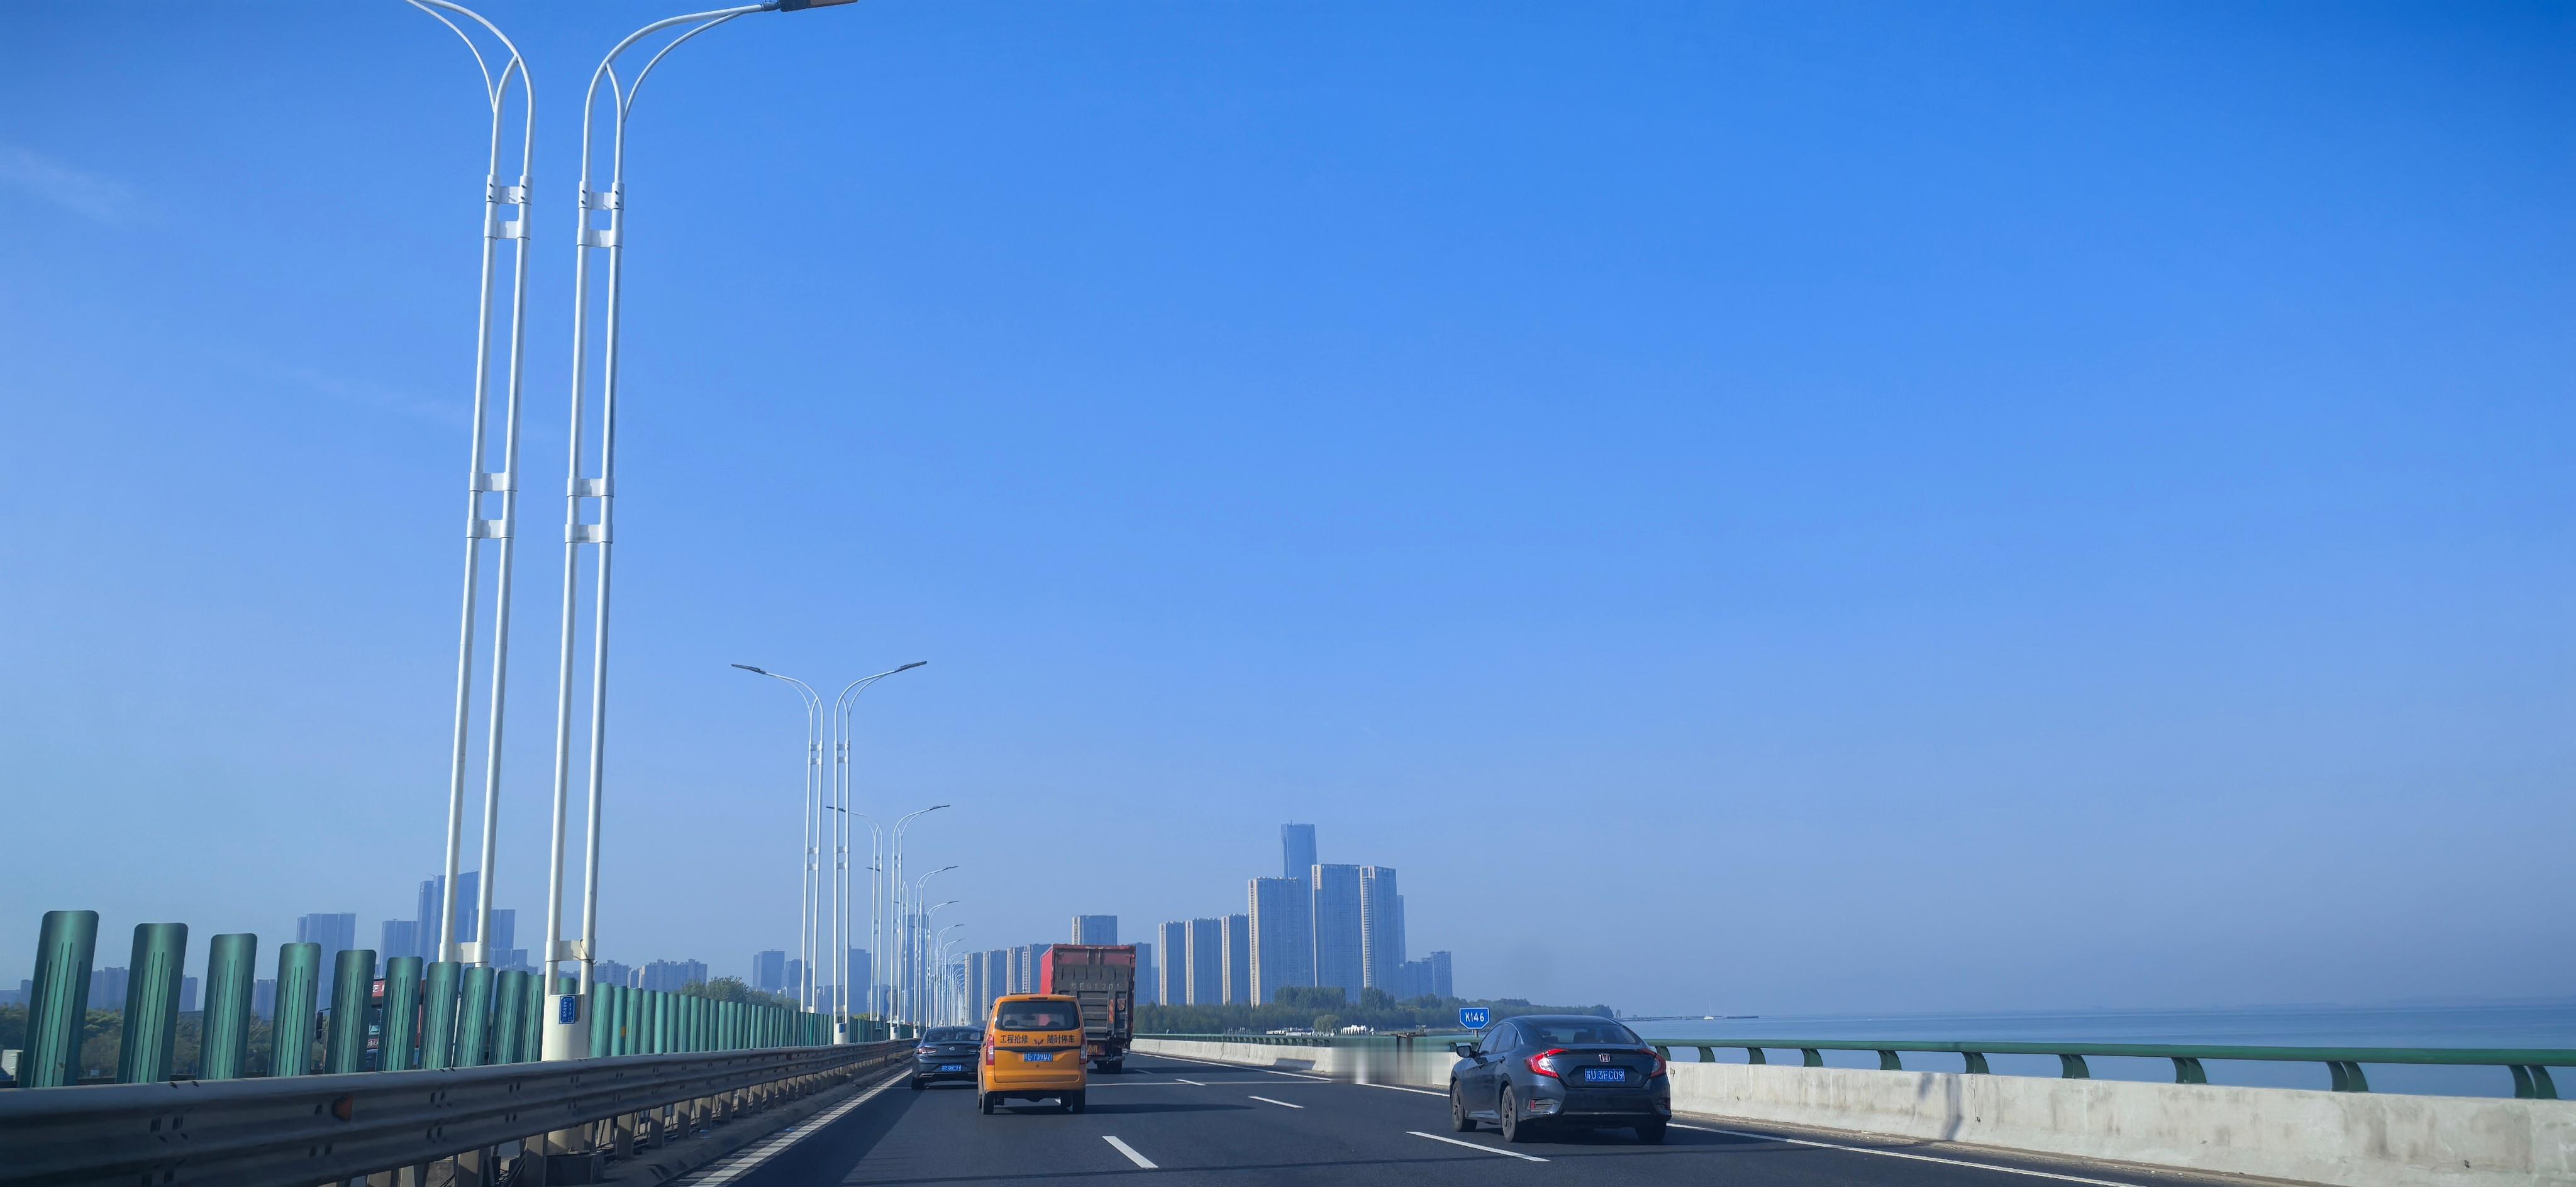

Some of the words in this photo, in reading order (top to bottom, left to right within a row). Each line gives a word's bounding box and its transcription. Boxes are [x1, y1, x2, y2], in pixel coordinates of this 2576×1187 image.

[1465, 1012, 1485, 1022] K146
[1001, 1034, 1028, 1044] 工程抢修
[1047, 1034, 1075, 1044] 随时停车
